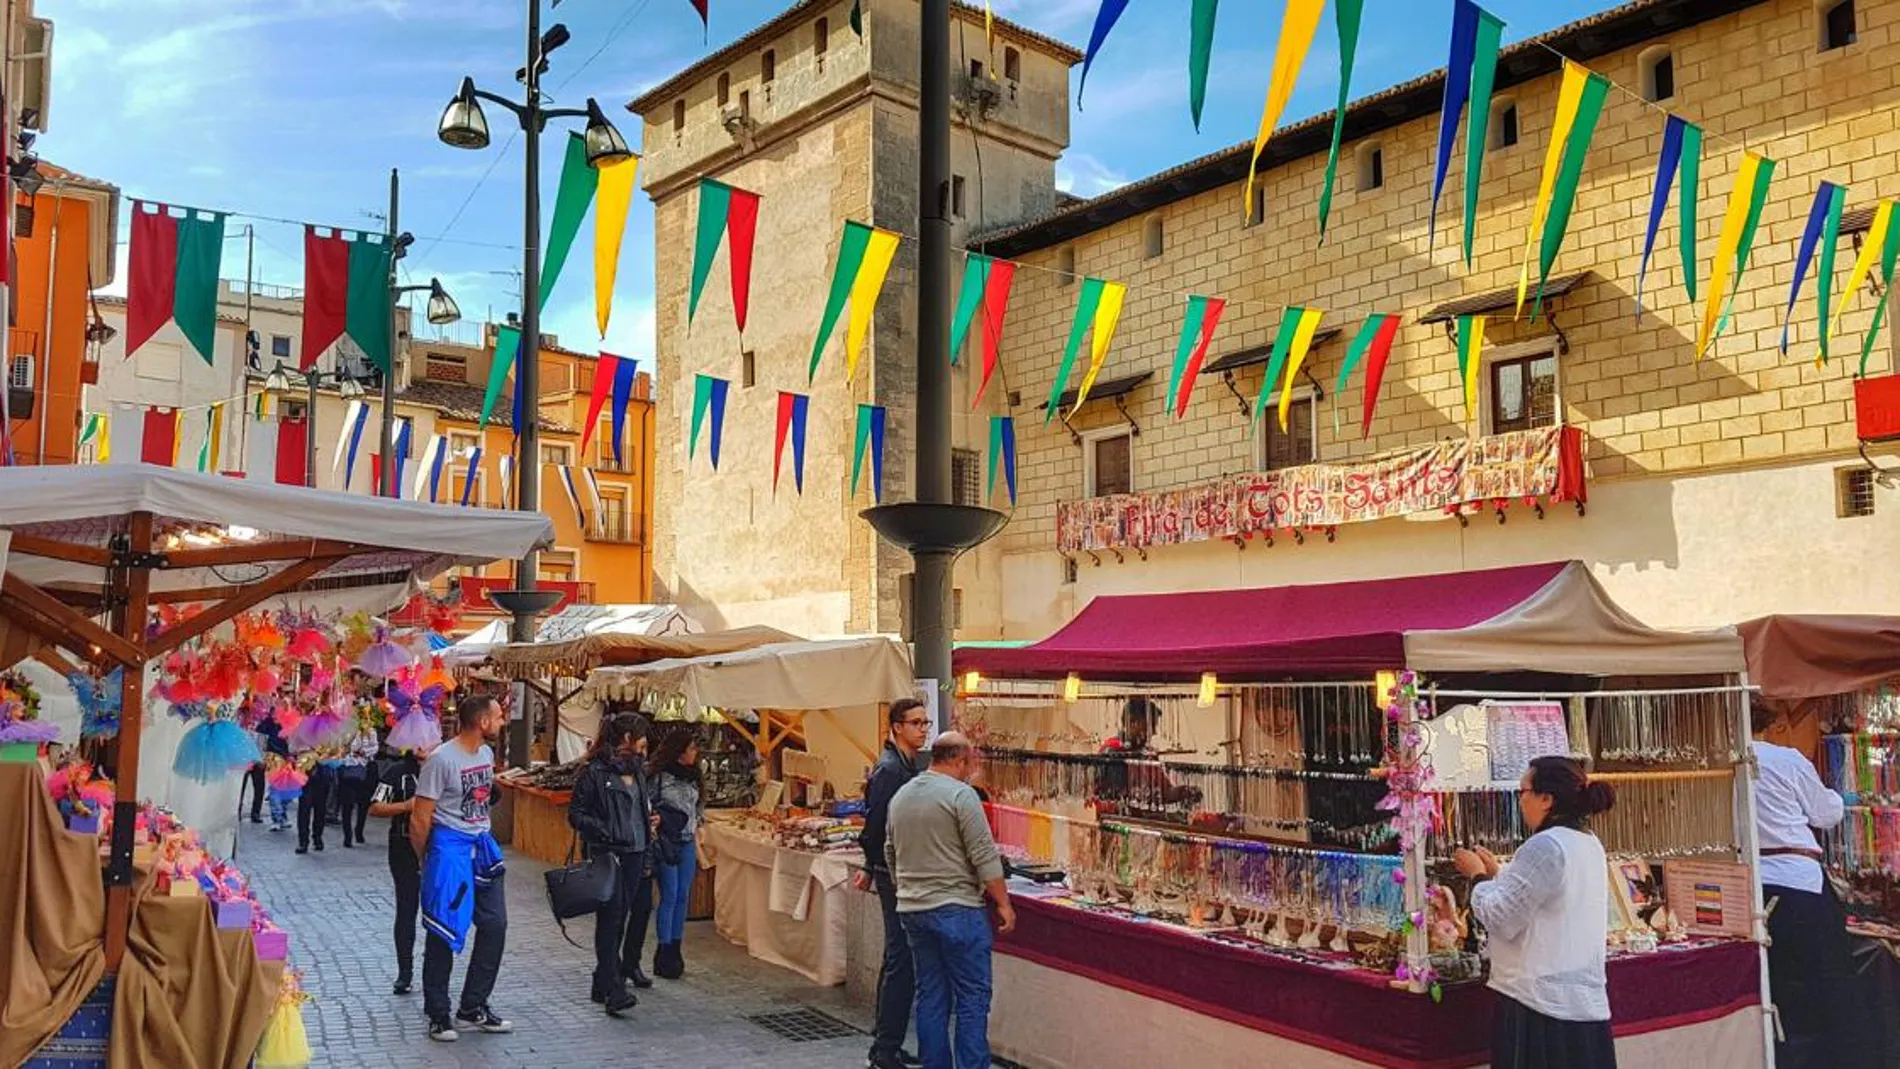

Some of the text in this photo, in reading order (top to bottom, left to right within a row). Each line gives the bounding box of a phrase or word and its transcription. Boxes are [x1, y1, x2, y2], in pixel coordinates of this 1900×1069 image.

[1126, 462, 1459, 536] Fira de Tots Sants
